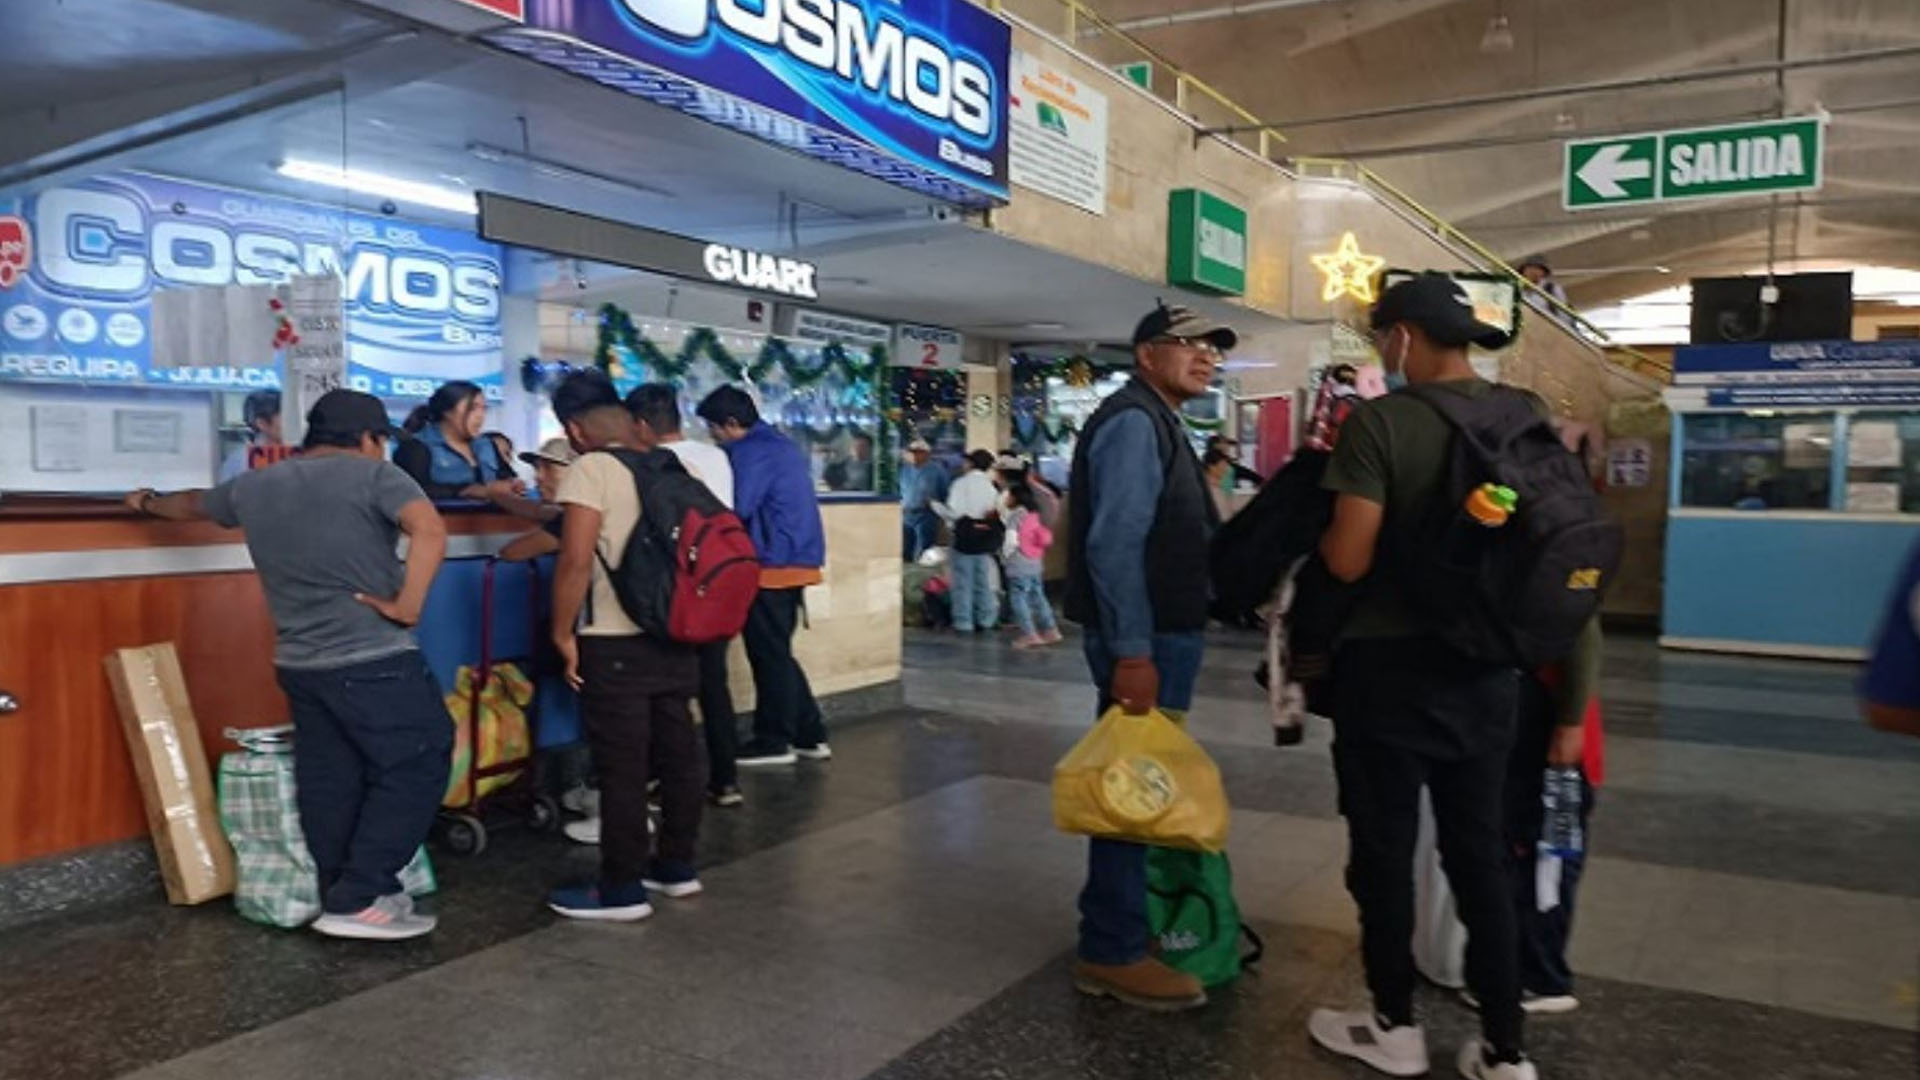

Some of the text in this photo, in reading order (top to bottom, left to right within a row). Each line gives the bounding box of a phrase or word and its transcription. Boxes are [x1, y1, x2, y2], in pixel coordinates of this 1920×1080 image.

[1671, 133, 1804, 186] SALIDA
[36, 188, 500, 319] COSMOS
[0, 354, 140, 380] REQUIPA
[922, 343, 938, 366] 2
